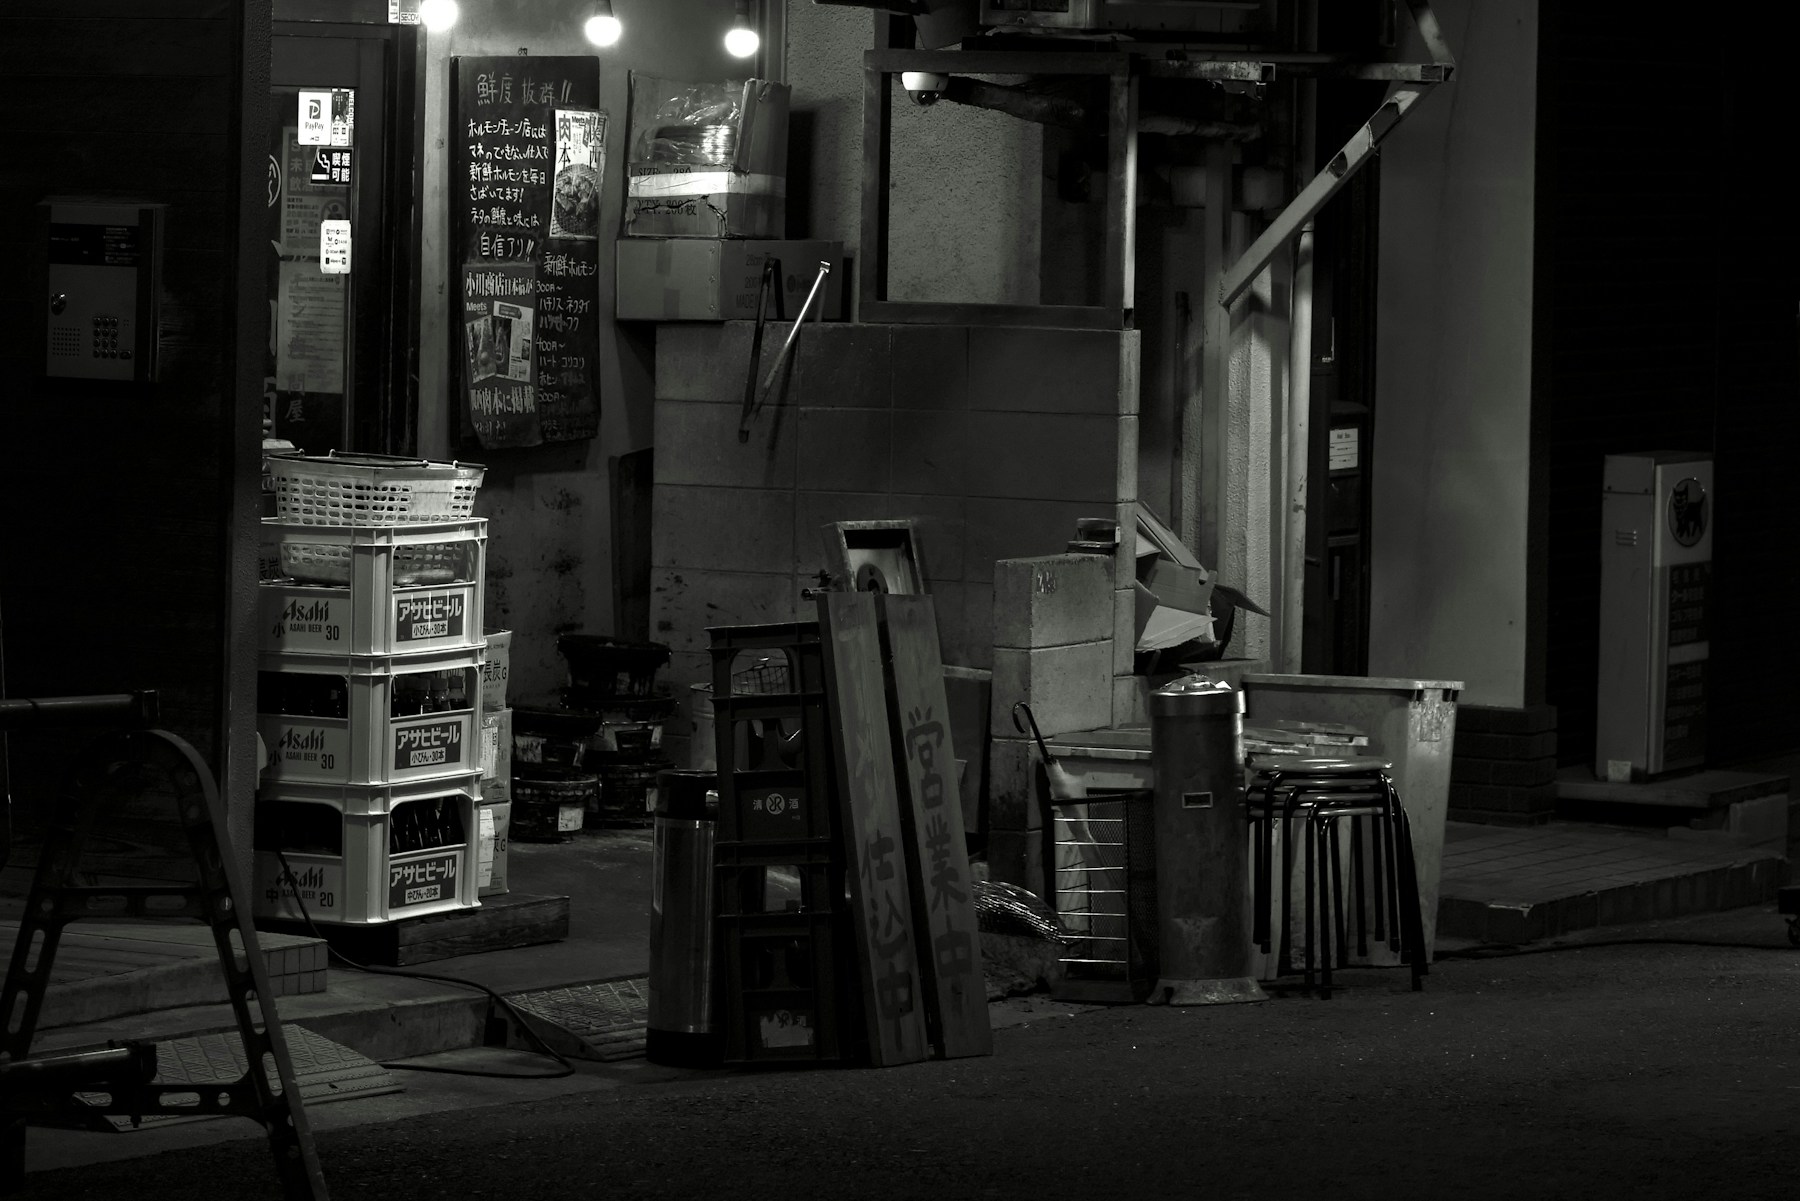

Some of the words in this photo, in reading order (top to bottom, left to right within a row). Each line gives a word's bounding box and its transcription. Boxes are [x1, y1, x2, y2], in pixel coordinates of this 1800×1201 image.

[304, 121, 325, 132] PayPay
[331, 167, 351, 182] 可能
[469, 161, 546, 185] 新鮮ホルモンを毎日
[543, 252, 598, 277] 新鮮ホルモン
[466, 301, 488, 312] Meets
[282, 598, 329, 623] Asahi
[398, 597, 462, 622] アサヒビール
[271, 622, 286, 638] 小
[289, 623, 306, 633] ASAHI
[325, 625, 340, 641] 30
[278, 727, 325, 751] Asahi
[397, 724, 460, 750] アサヒビール
[268, 749, 282, 766] 小
[285, 751, 302, 761] ASAHI
[320, 753, 335, 770] 30
[906, 704, 973, 1014] 営業中
[390, 858, 456, 887] アサヒビール
[265, 887, 279, 905] 中
[319, 891, 334, 907] 20
[861, 829, 914, 1050] 仕込中
